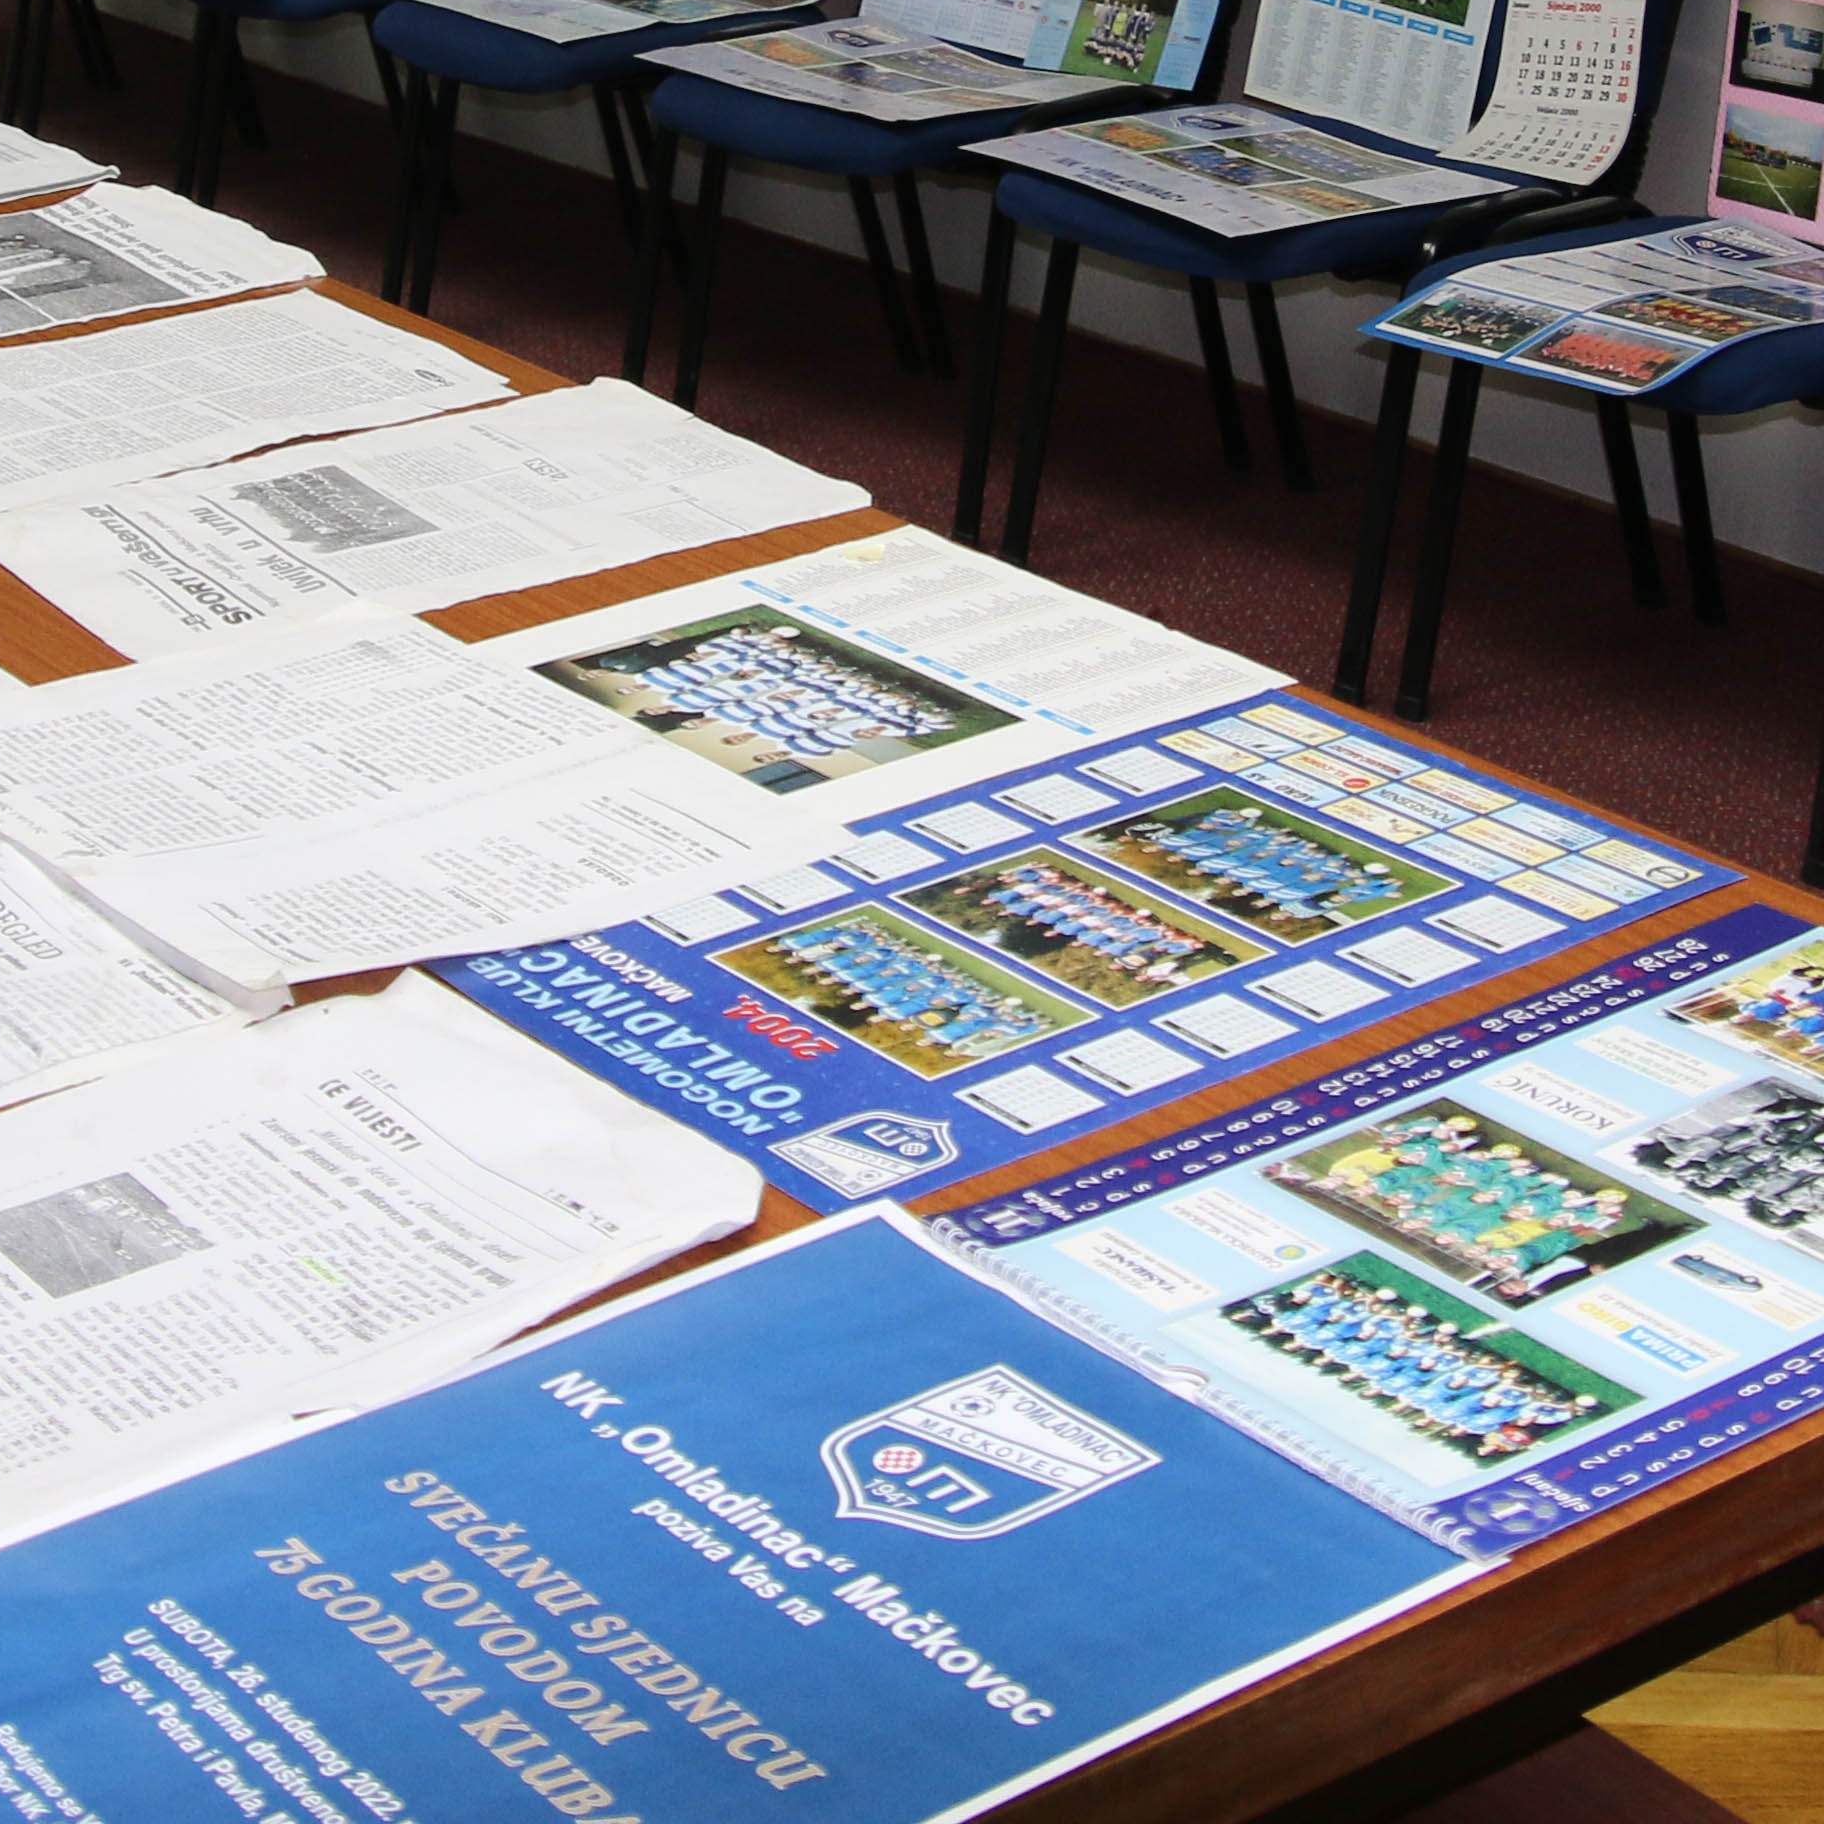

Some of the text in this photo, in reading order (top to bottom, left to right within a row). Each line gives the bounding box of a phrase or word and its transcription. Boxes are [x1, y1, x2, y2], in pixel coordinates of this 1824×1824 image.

[1547, 1, 1601, 13] Siječanj 2000
[99, 517, 171, 571] vašem
[187, 504, 328, 595] Uvijek u vrhu
[168, 574, 254, 627] SPORT
[1244, 771, 1321, 804] AGRO AS
[564, 933, 695, 1004] MAČKOVE
[461, 954, 777, 1137] NOGOMETNI KLUB
[715, 993, 841, 1064] 2004.
[341, 1093, 423, 1154] VIJESTI
[1488, 1072, 1619, 1132] KORUNIĆ
[976, 1208, 1032, 1233] II
[1015, 1190, 1079, 1222] veljača
[1619, 1326, 1710, 1372] PRIMA
[1780, 1354, 1821, 1375] 10
[1735, 1381, 1767, 1396] 8
[916, 1418, 1072, 1479] MAČKOVEC
[975, 1377, 1133, 1470] NK "OMLADINAC"
[1579, 1452, 1612, 1469] 2
[860, 1476, 919, 1511] 1947
[1513, 1470, 1596, 1516] siječanj
[534, 1369, 625, 1420] NK
[827, 1571, 1072, 1729] Mačkovec
[629, 1496, 828, 1627] poziva Vas na
[118, 1627, 154, 1647] U
[247, 1535, 326, 1579] 75
[289, 1566, 491, 1716] GODINA
[379, 1467, 828, 1792] SVEČANU SJEDNICU
[390, 1558, 649, 1747] POVODOM
[128, 1641, 262, 1744] prostorijama
[142, 1596, 413, 1823] SUBOTA, 26. studenog 2022.
[81, 1653, 279, 1819] Trg sv. Petra i Pavla,
[6, 1790, 55, 1821] NK
[51, 1795, 90, 1819] se
